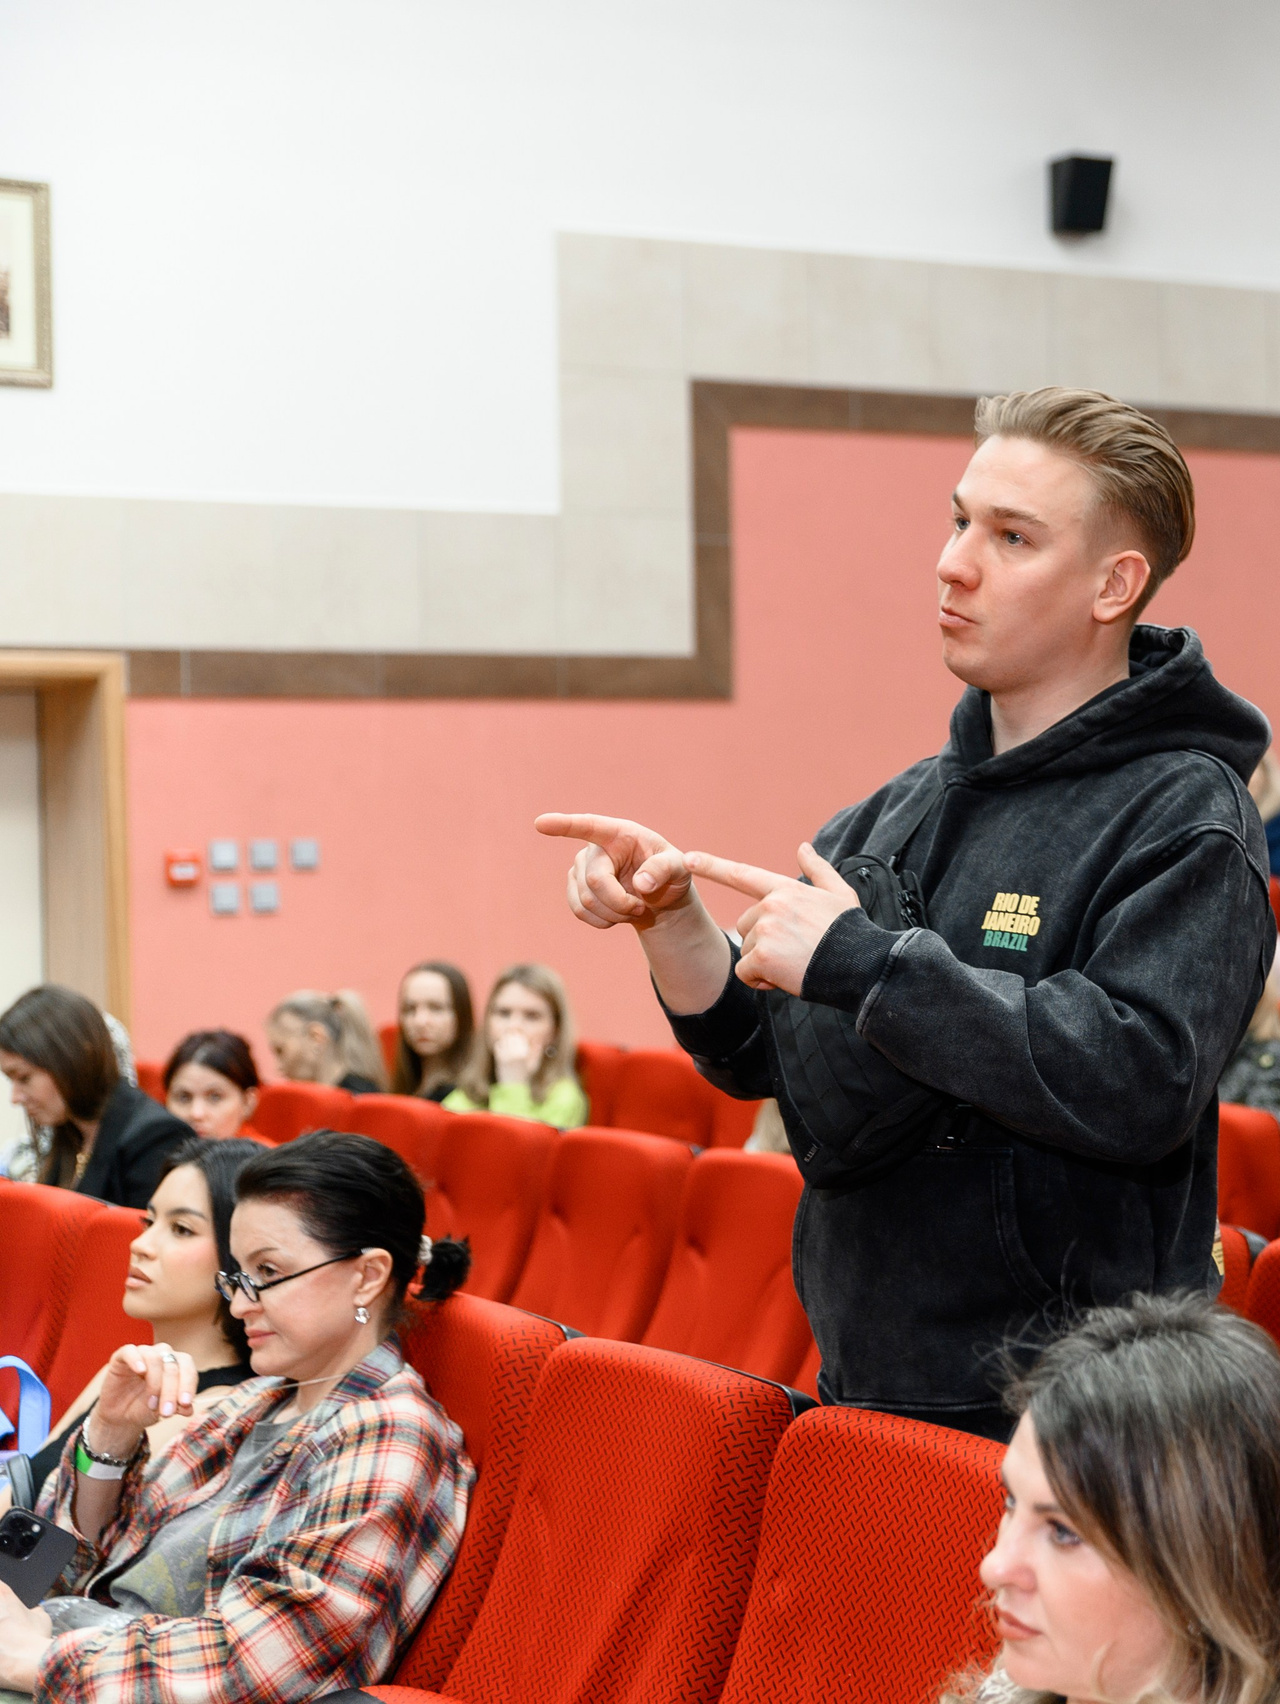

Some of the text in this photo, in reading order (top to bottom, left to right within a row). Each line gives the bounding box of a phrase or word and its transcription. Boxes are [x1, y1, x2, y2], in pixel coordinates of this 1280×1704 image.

[992, 892, 1040, 916] RIO DE
[981, 910, 1041, 936] JANEIRO
[983, 930, 1029, 952] BRAZIL
